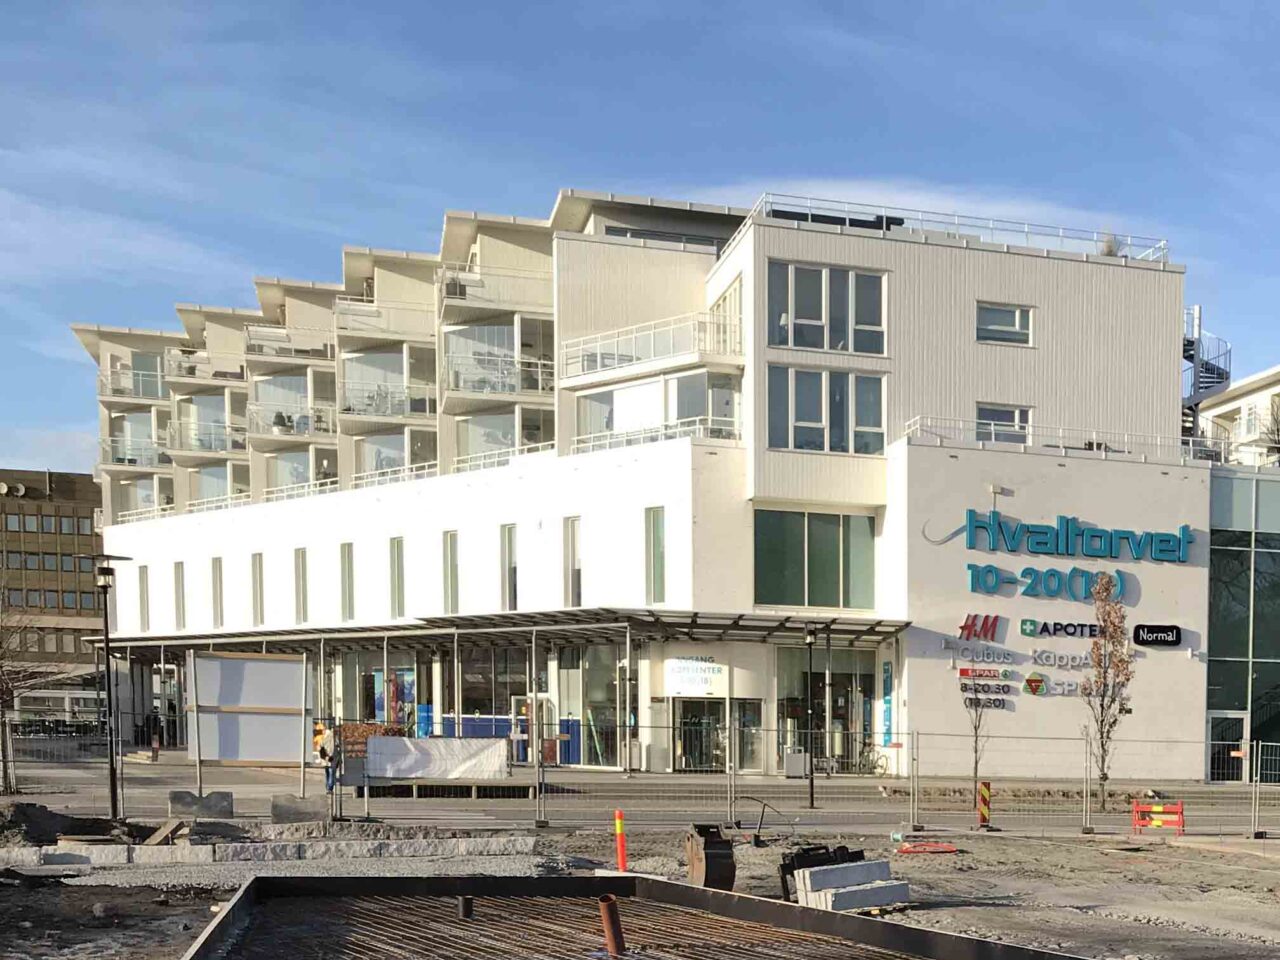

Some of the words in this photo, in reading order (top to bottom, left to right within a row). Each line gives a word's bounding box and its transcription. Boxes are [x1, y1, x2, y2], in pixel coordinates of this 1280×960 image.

[965, 508, 1196, 562] Hvaltorvet
[966, 563, 1125, 602] 10-20(1)
[958, 613, 999, 642] H&M
[1138, 628, 1177, 642] Normal
[959, 646, 1013, 663] Cubus
[967, 669, 999, 678] SPAR
